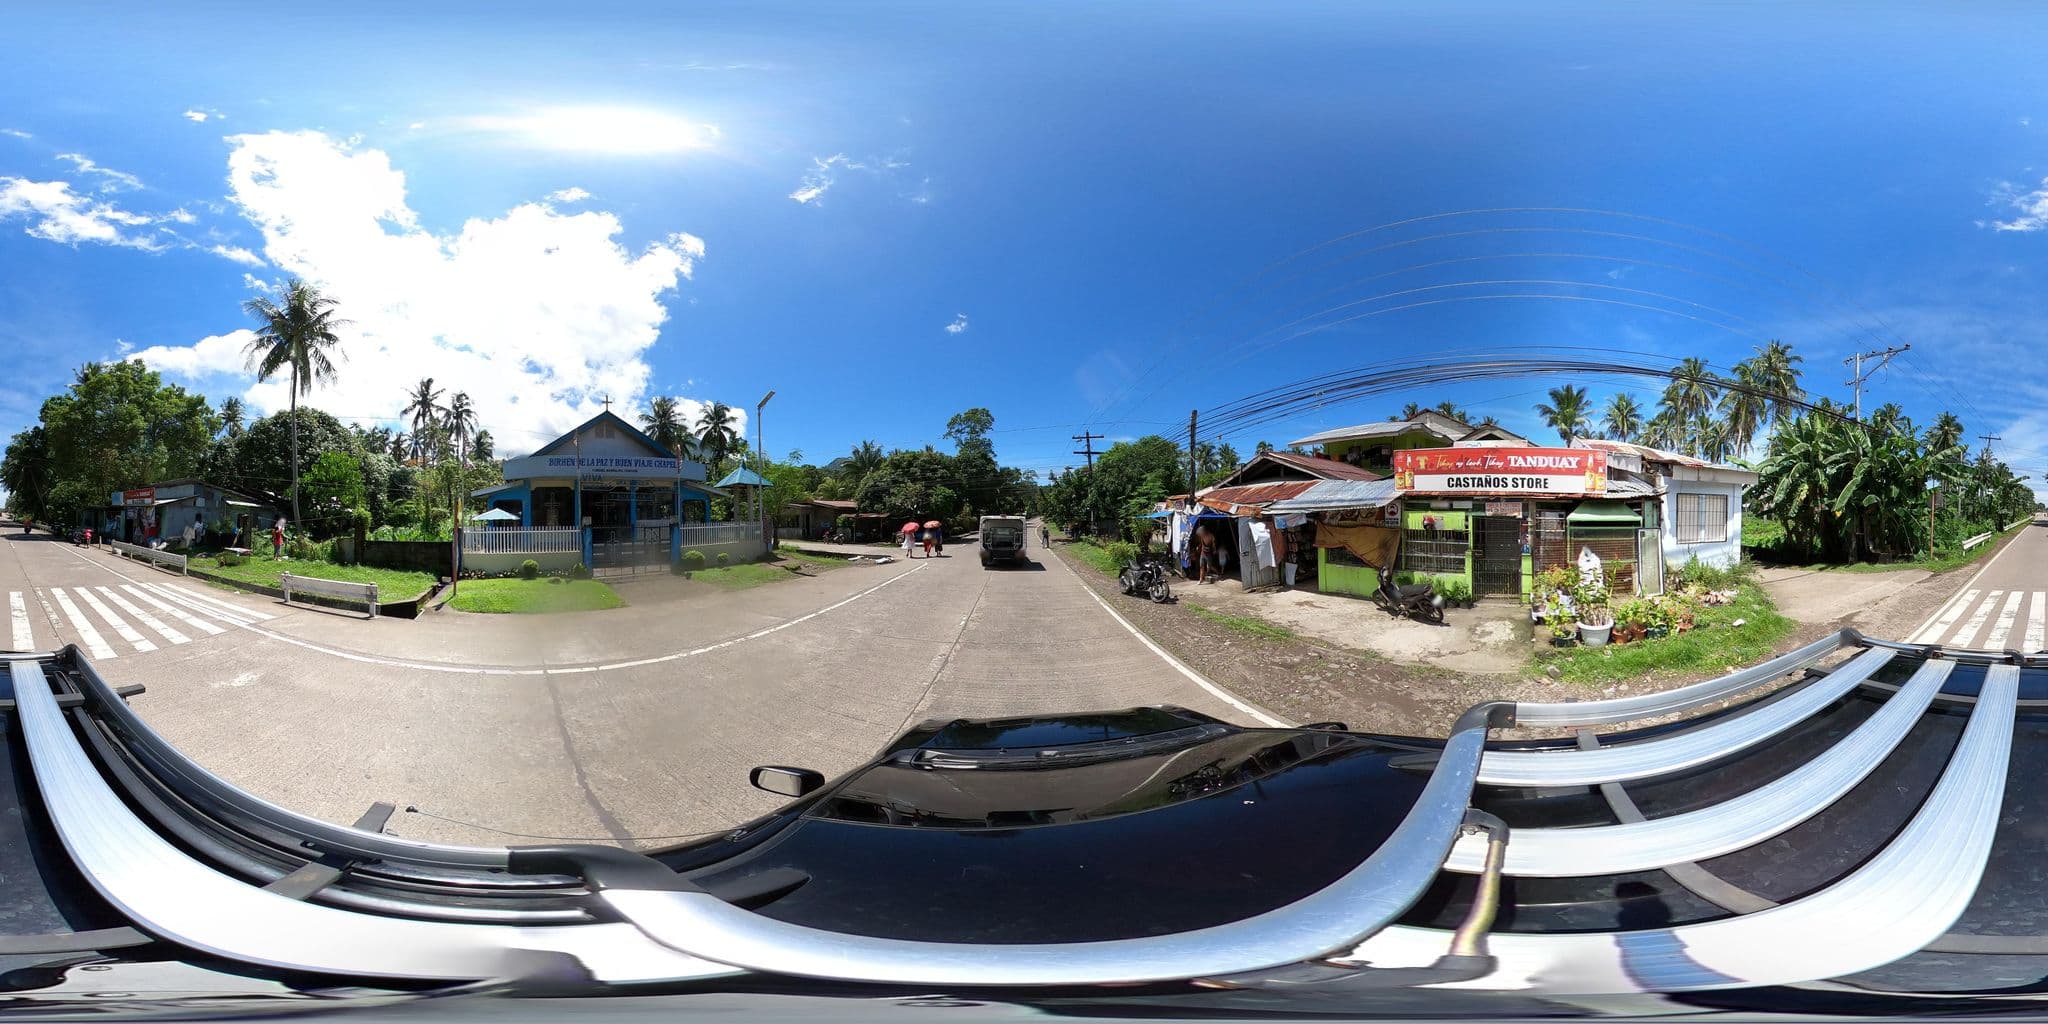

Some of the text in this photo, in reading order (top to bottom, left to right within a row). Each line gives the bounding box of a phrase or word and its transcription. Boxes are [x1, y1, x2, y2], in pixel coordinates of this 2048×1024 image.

[596, 458, 608, 467] PAZ
[634, 459, 652, 468] VIAJE
[654, 460, 676, 469] CHAPEL
[1507, 455, 1580, 469] TANDUAY
[1447, 475, 1549, 489] CASTAÑOS STORE
